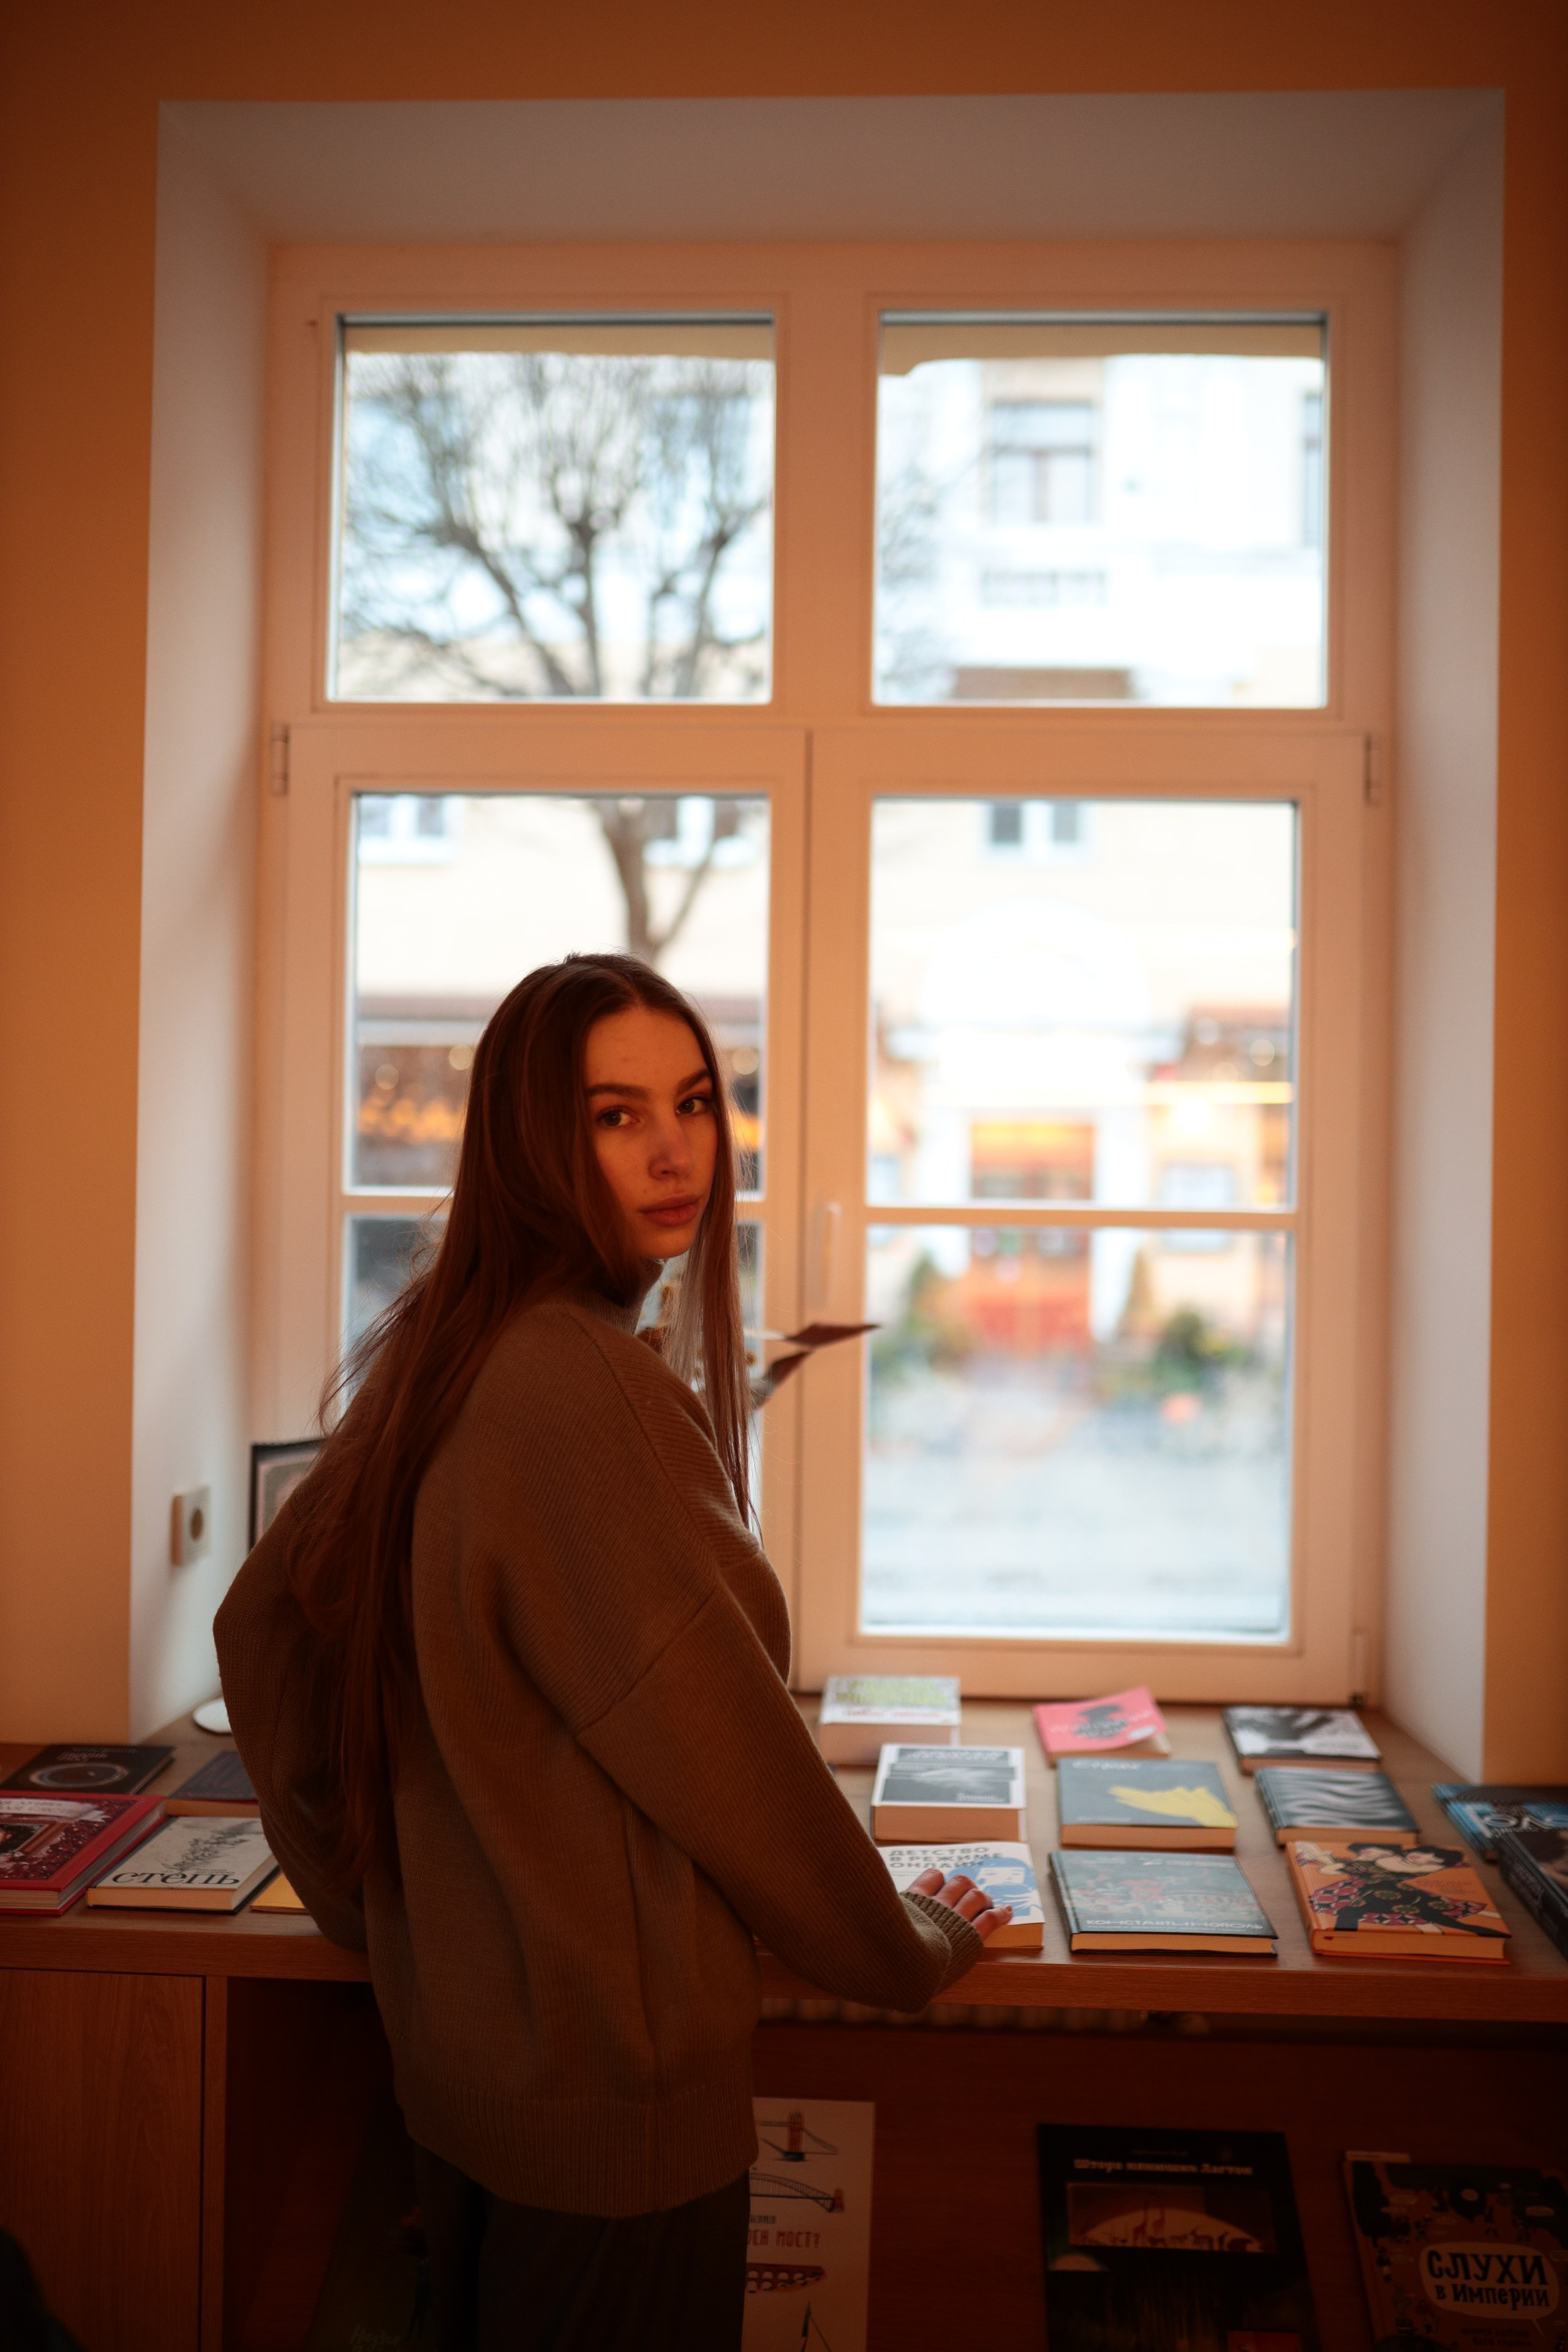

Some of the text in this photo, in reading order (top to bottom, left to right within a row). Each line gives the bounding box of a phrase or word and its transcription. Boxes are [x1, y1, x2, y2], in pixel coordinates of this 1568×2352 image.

[889, 1847, 989, 1856] ДЕТСТВО
[908, 1853, 1003, 1863] РЕЖИМЕ
[1086, 1919, 1264, 1931] КОНСТАНТИНОПОЛЬ
[776, 2230, 821, 2248] МОСТ?
[1427, 2250, 1550, 2286] СЛУХИ
[1435, 2283, 1551, 2311] в Империи
